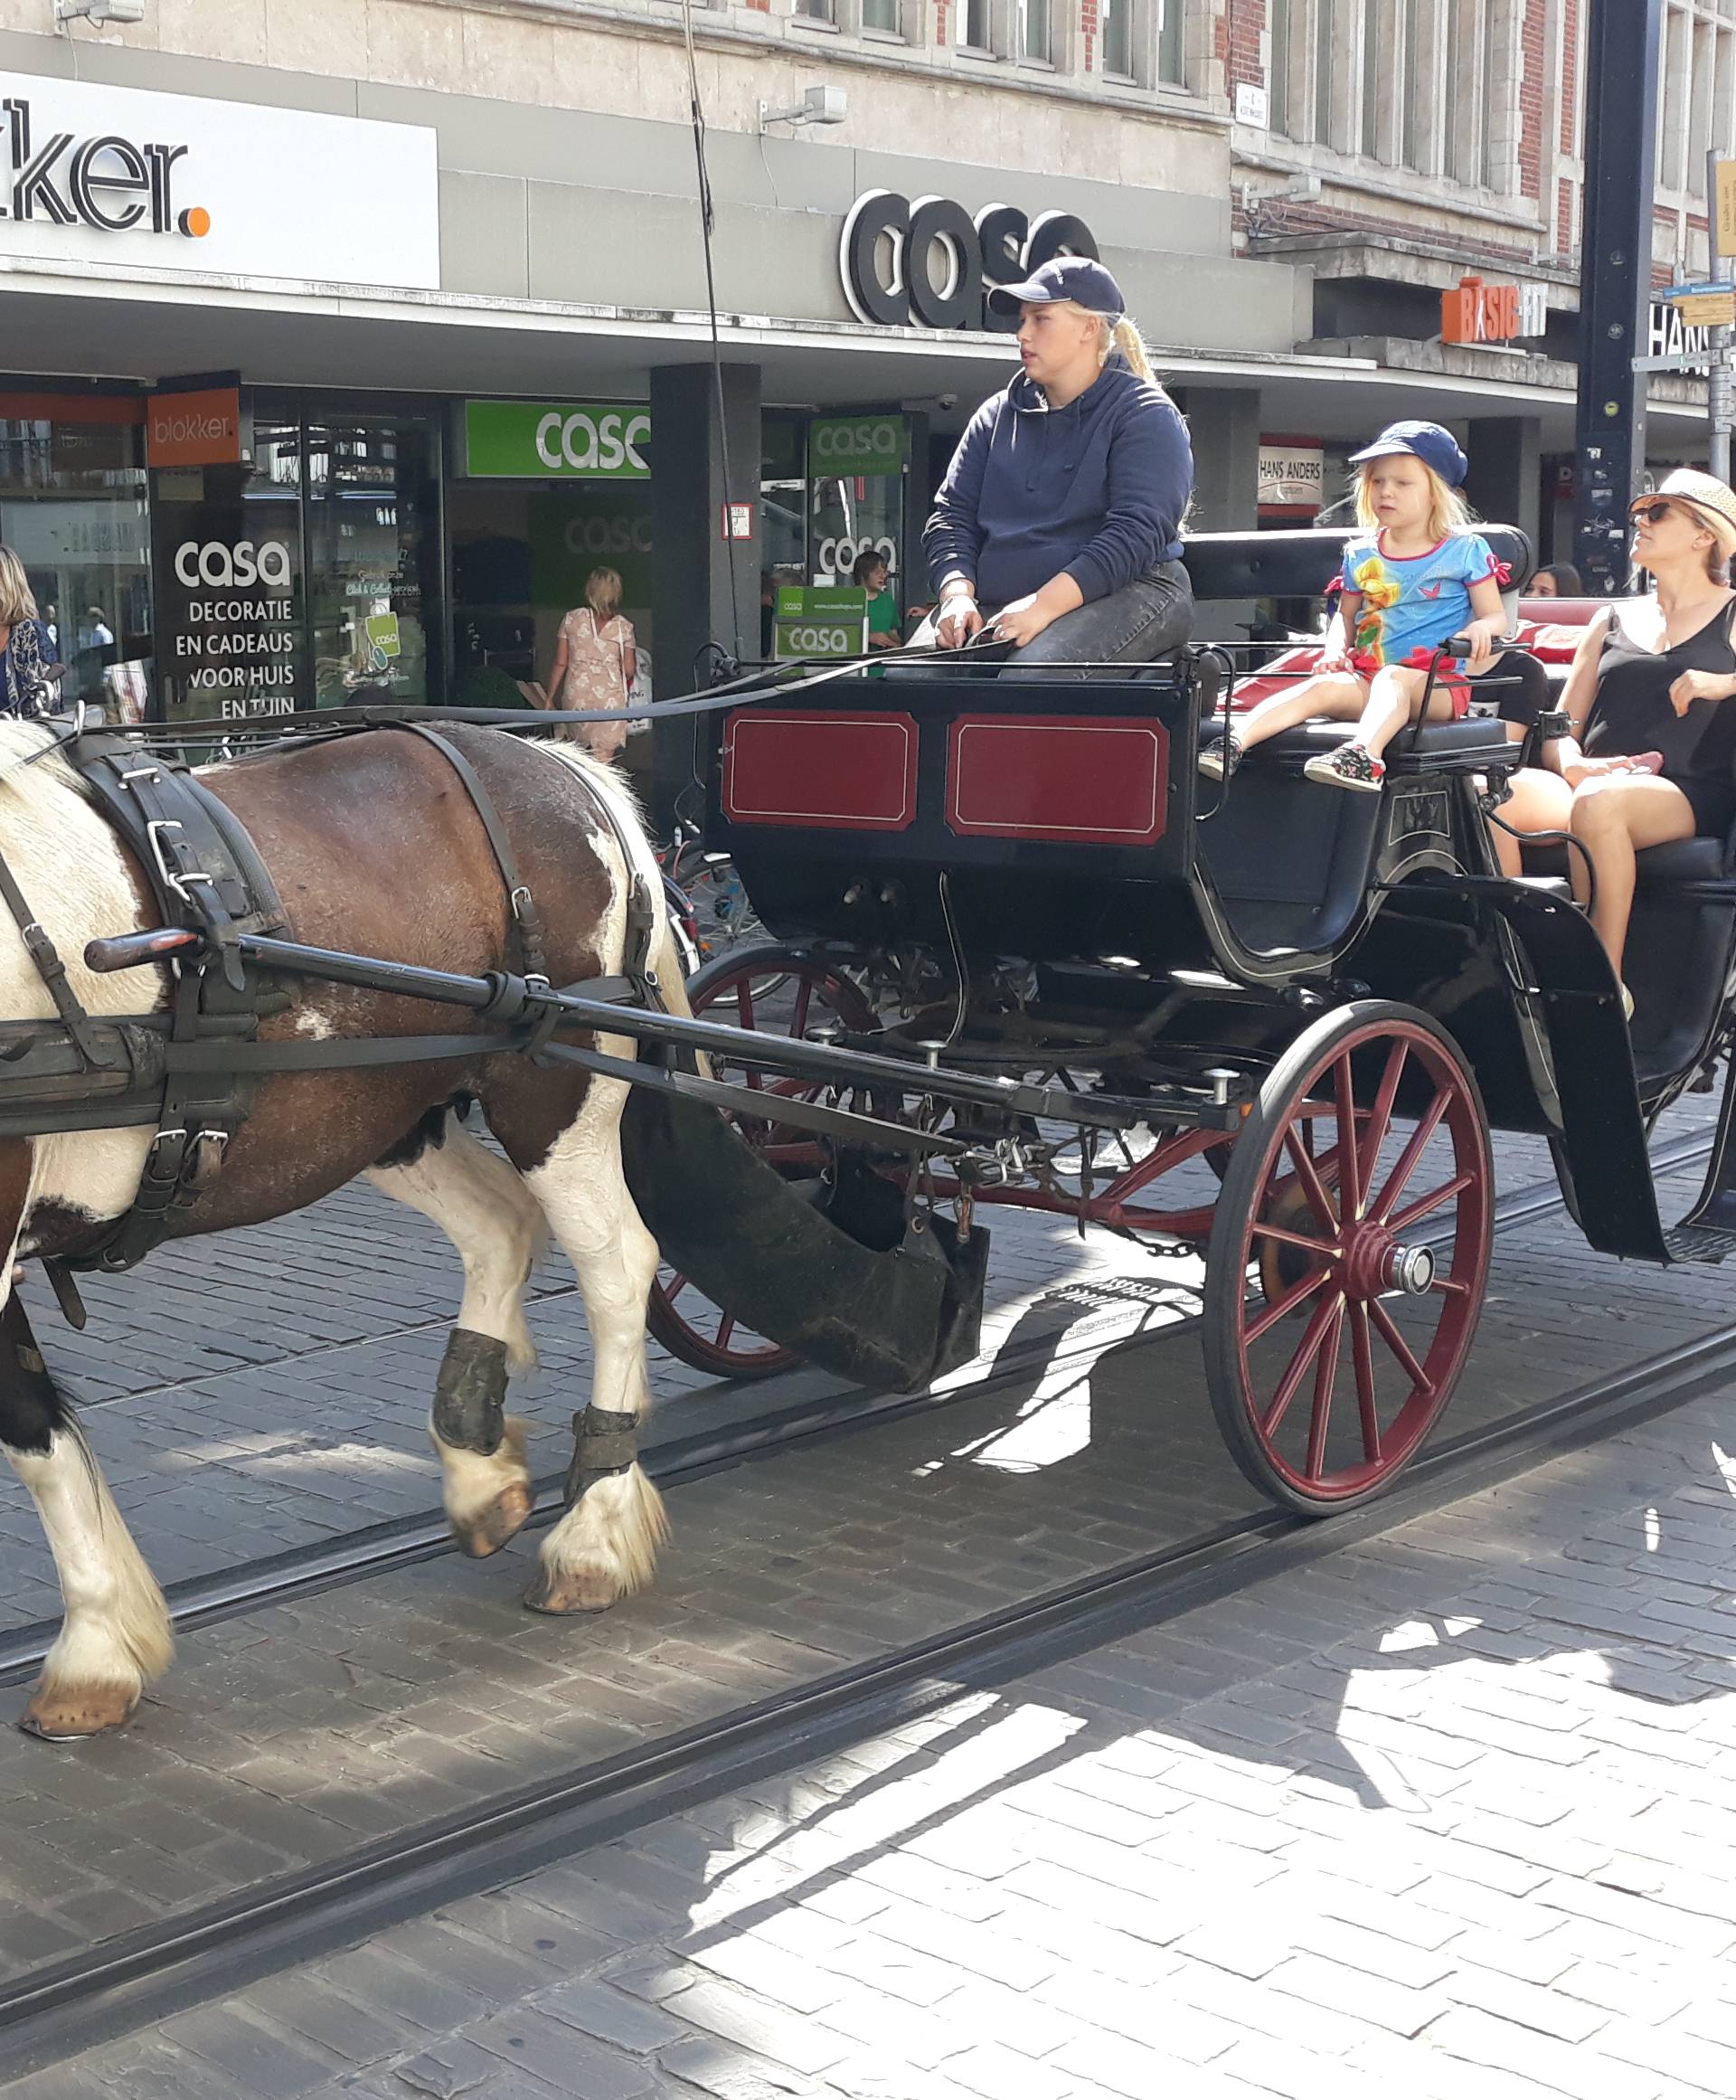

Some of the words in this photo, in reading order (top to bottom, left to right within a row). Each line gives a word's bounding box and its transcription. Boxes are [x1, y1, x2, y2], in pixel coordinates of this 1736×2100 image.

[817, 423, 897, 457] casa
[1260, 460, 1284, 478] HANS
[1287, 462, 1320, 479] ANDERS
[175, 541, 290, 587] casa
[189, 600, 293, 622] DECORATIE
[175, 635, 202, 656] EN
[206, 632, 294, 655] CADEAUS
[375, 634, 399, 646] casa
[789, 628, 847, 652] casa
[191, 667, 246, 688] VOOR
[250, 665, 295, 686] HUIS
[222, 699, 246, 719] EN
